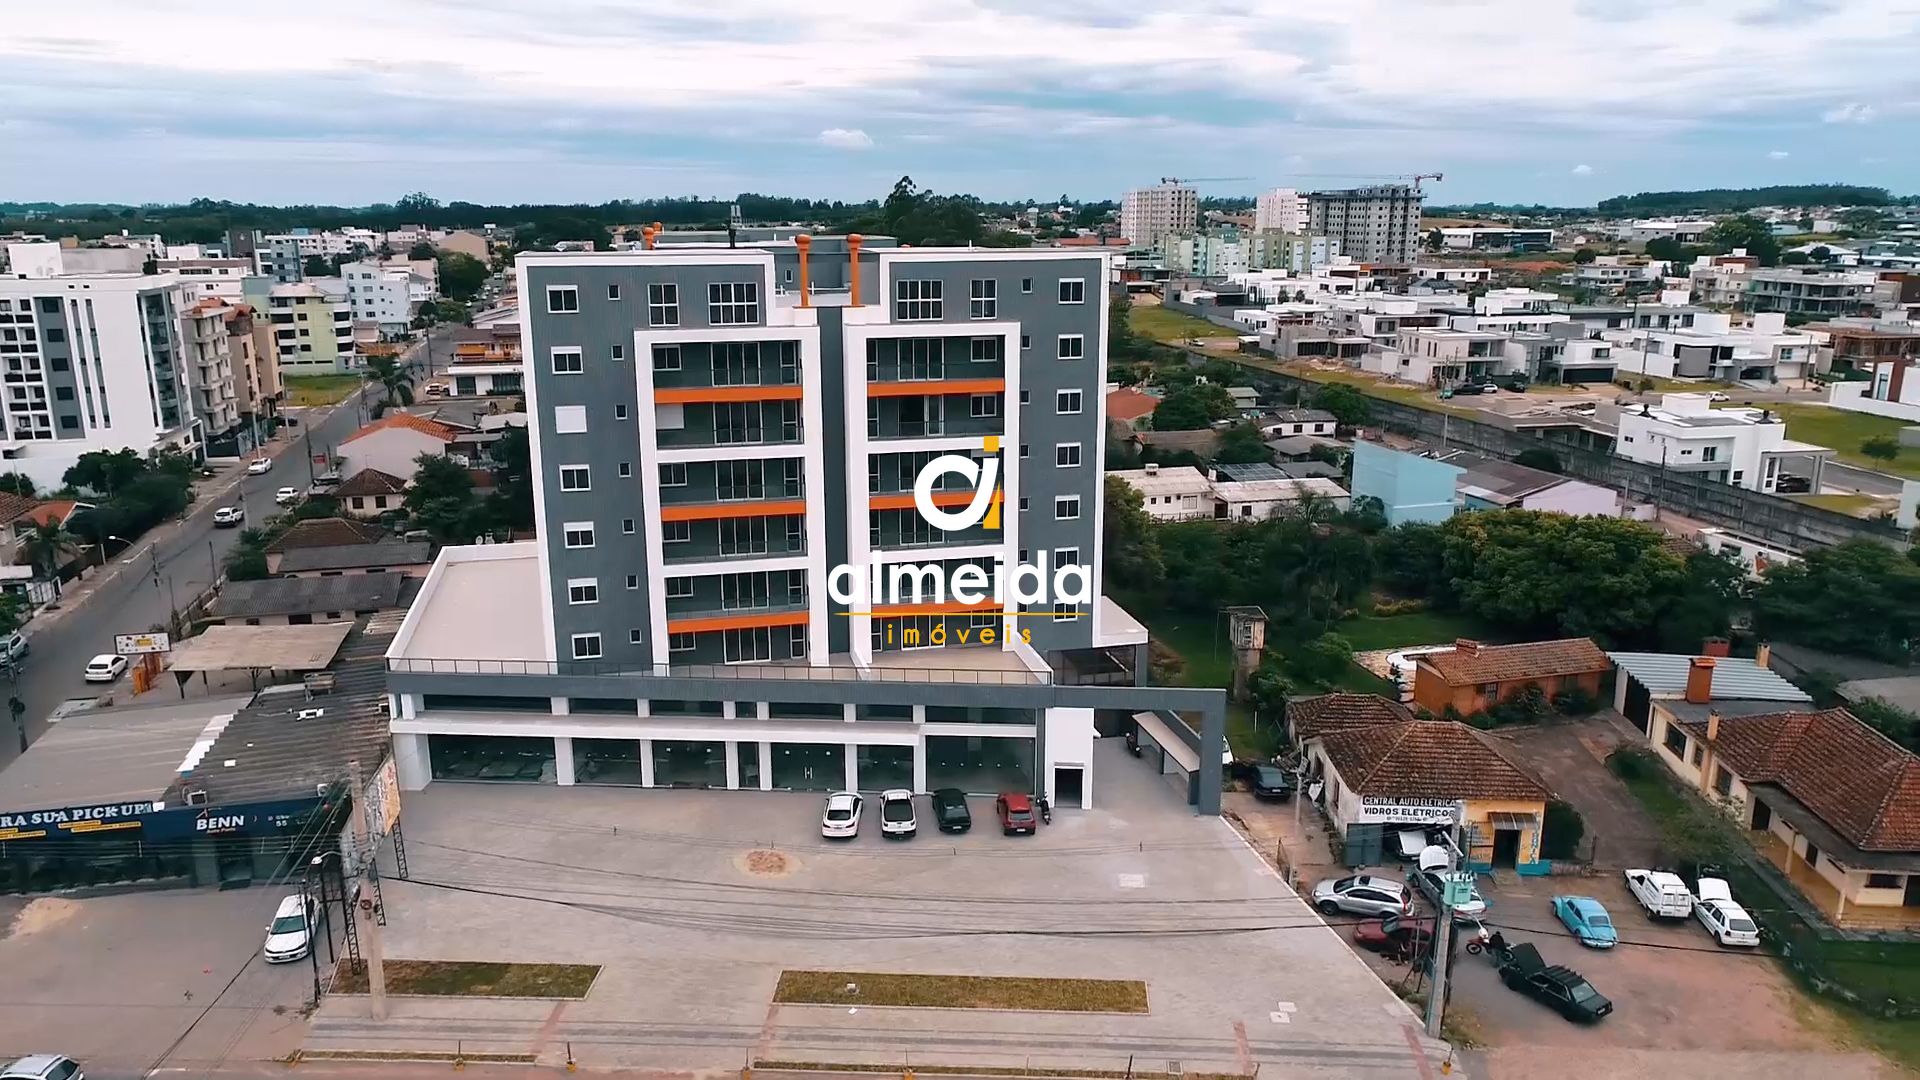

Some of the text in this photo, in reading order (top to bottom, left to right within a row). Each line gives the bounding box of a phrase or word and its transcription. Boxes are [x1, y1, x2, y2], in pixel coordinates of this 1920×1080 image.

[1364, 796, 1397, 805] CENTRAL
[1399, 797, 1419, 806] AUTO
[31, 810, 69, 824] SUA
[72, 806, 118, 821] PICK
[1364, 807, 1399, 815] VIDROS
[196, 815, 245, 830] BENN
